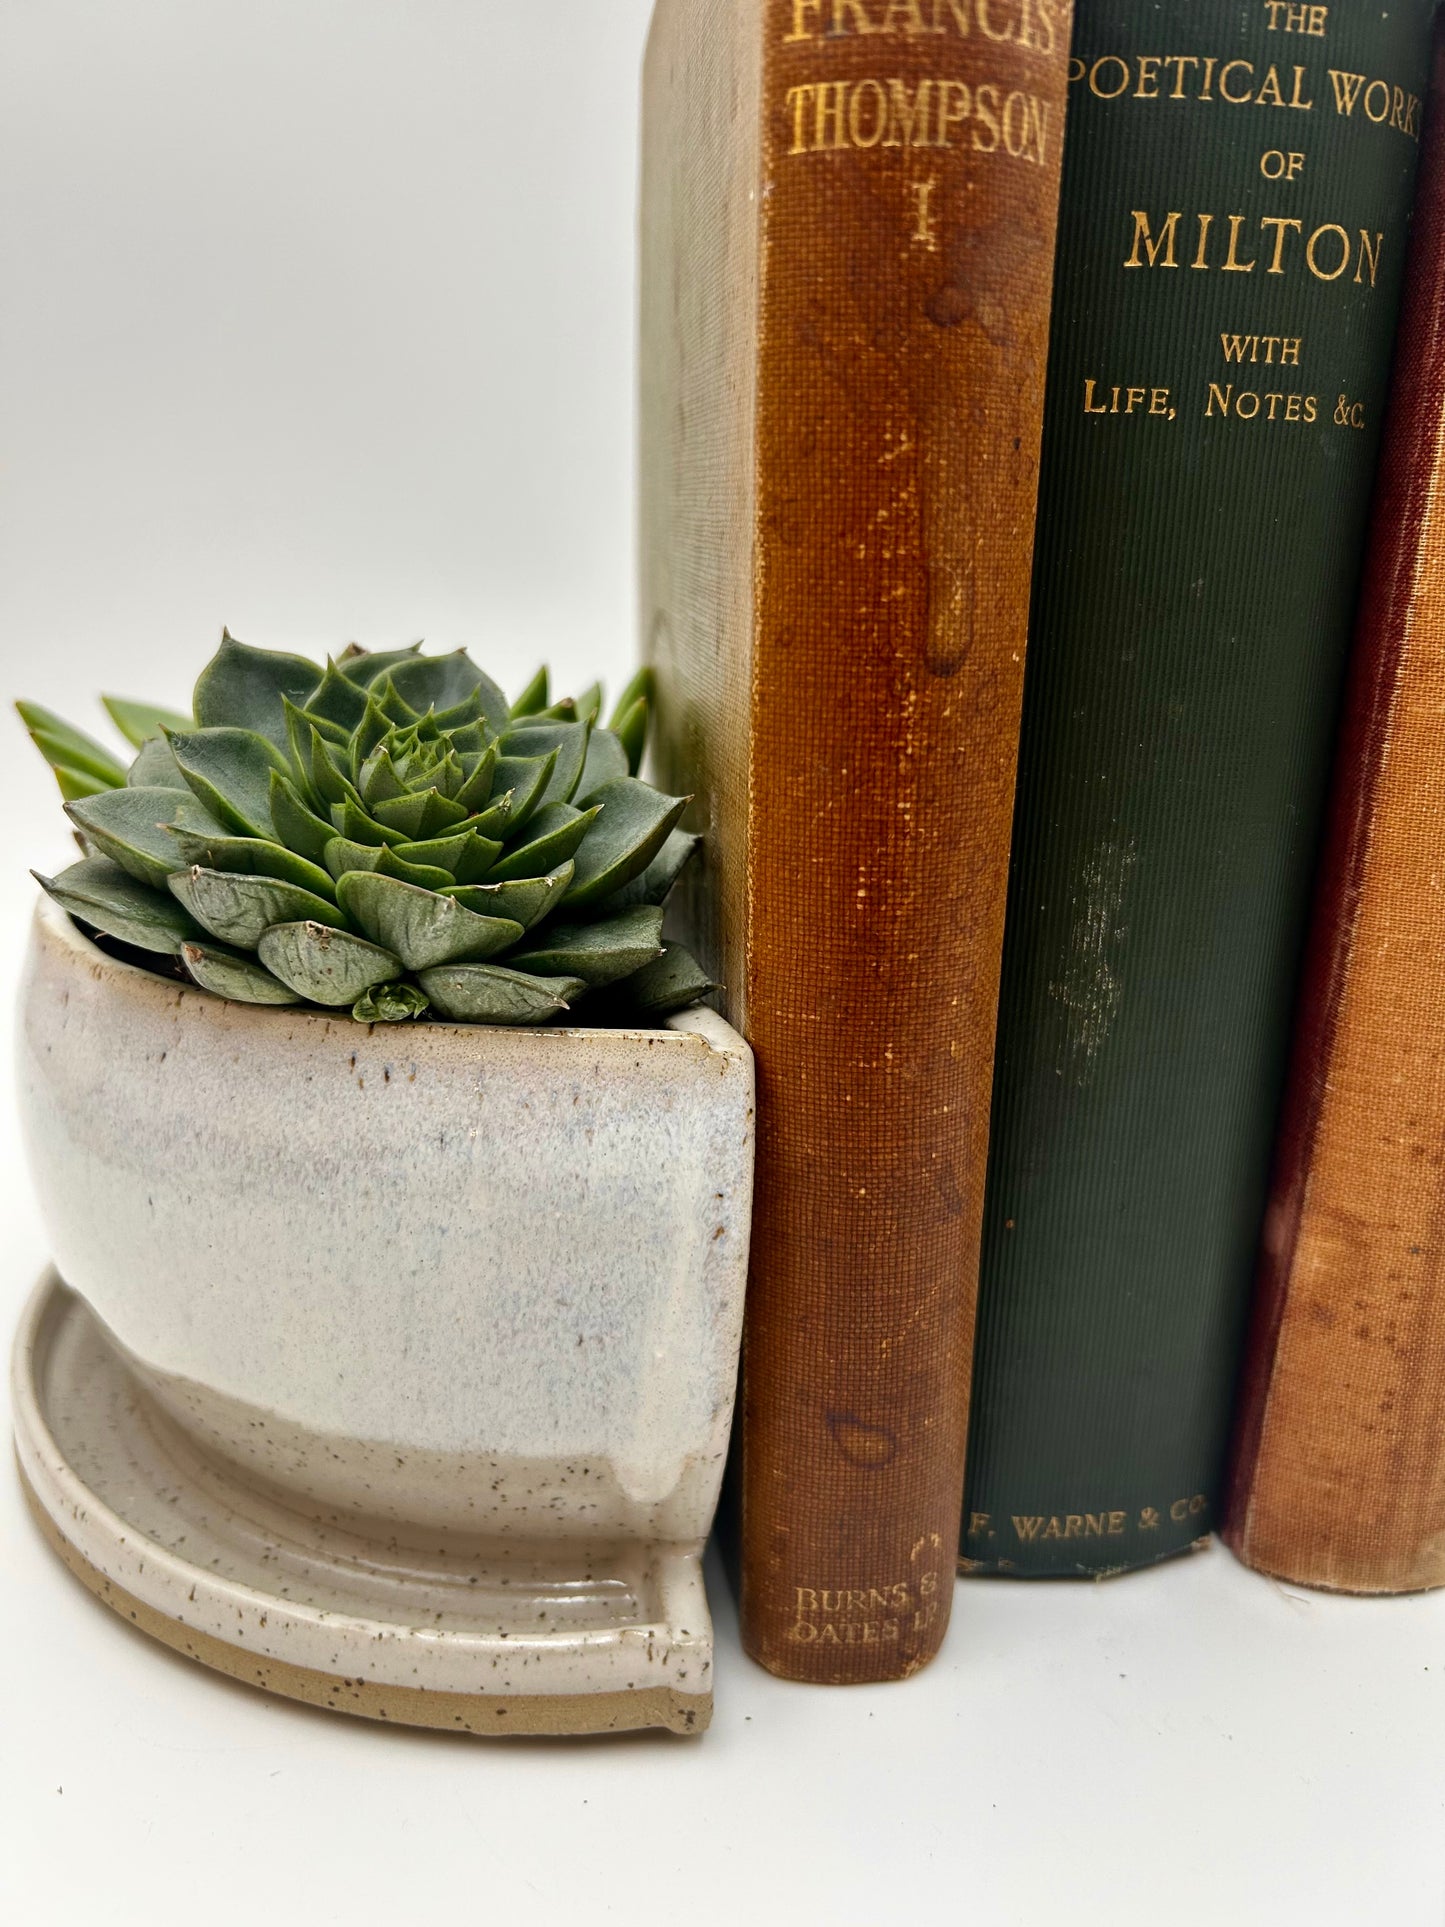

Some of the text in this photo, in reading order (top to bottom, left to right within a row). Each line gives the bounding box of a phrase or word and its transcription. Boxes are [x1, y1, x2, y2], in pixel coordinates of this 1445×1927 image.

[1264, 0, 1329, 37] THE
[786, 79, 1048, 166] THOMPSON
[1260, 150, 1305, 180] OF
[1123, 210, 1384, 288] MILTON
[1220, 333, 1302, 366] WITH
[967, 1511, 995, 1537] F.
[1011, 1511, 1127, 1541] WARNE
[1138, 1506, 1160, 1529] &
[796, 1582, 908, 1613] BURNS
